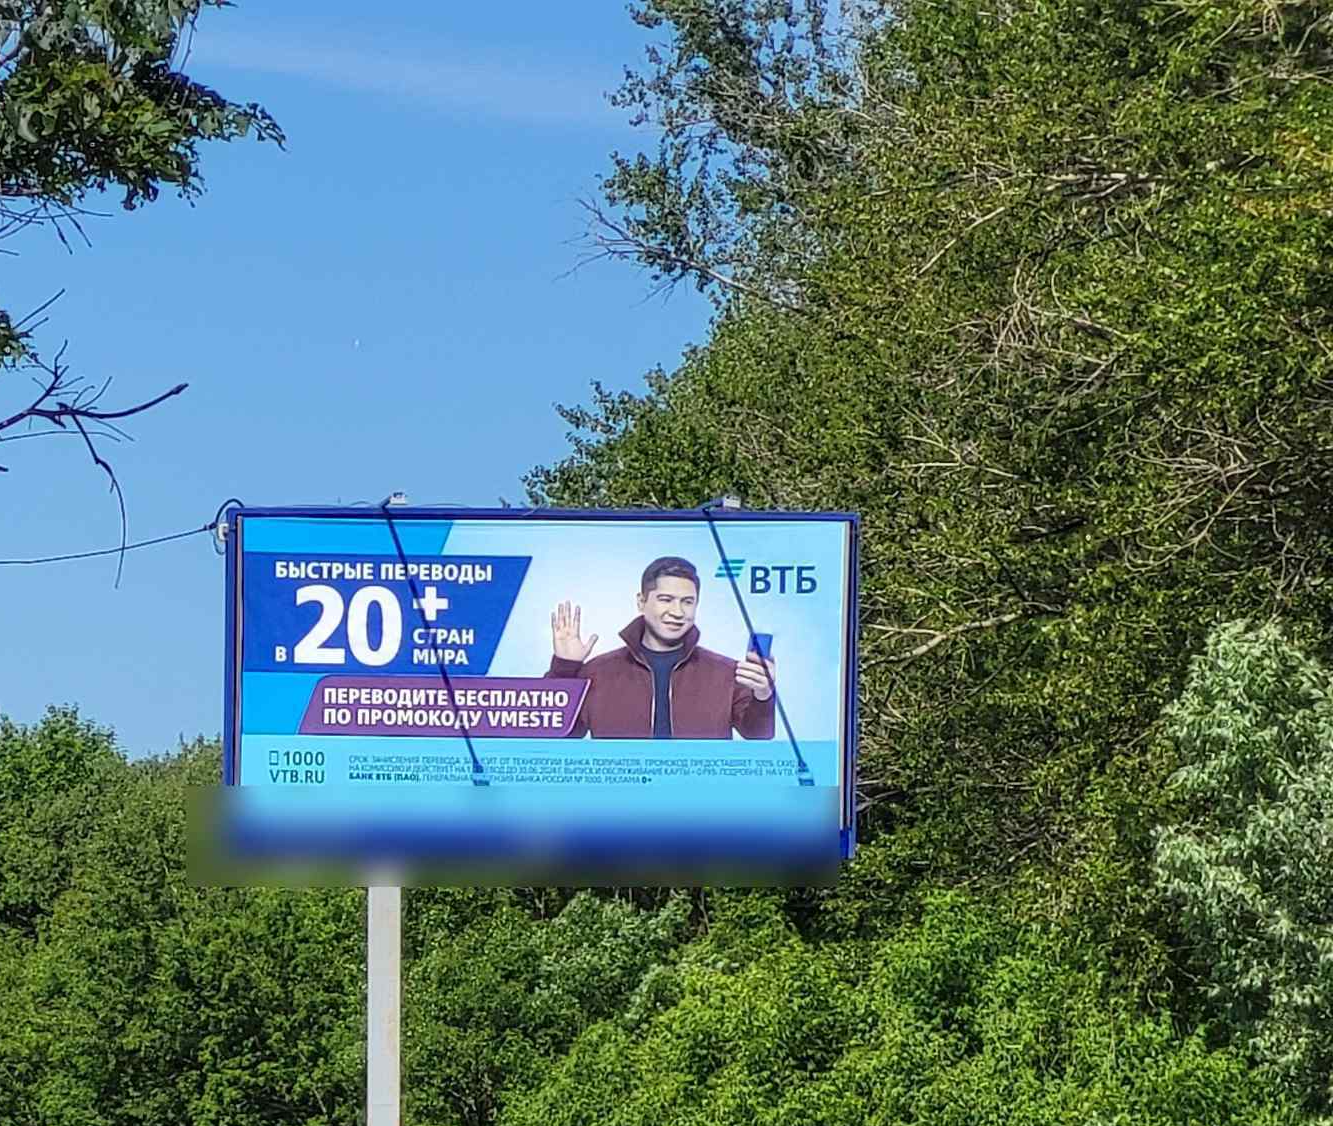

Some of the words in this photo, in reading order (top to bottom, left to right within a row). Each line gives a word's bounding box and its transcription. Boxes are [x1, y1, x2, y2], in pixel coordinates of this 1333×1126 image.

[275, 561, 374, 581] БЫСТРЫЕ
[380, 563, 493, 585] ПЕРЕВОДЫ
[750, 566, 817, 594] ВТБ
[413, 628, 474, 645] СТРАН
[413, 649, 469, 665] МИРА
[323, 688, 448, 709] ПЕРЕВОДИТЕ
[453, 690, 569, 709] БЕСПЛАТНО
[323, 708, 352, 725] ПО
[357, 709, 482, 730] ПРОМОКОДУ
[488, 712, 564, 729] VMESTE
[283, 750, 325, 767] 1000
[269, 769, 325, 784] VTB.RU
